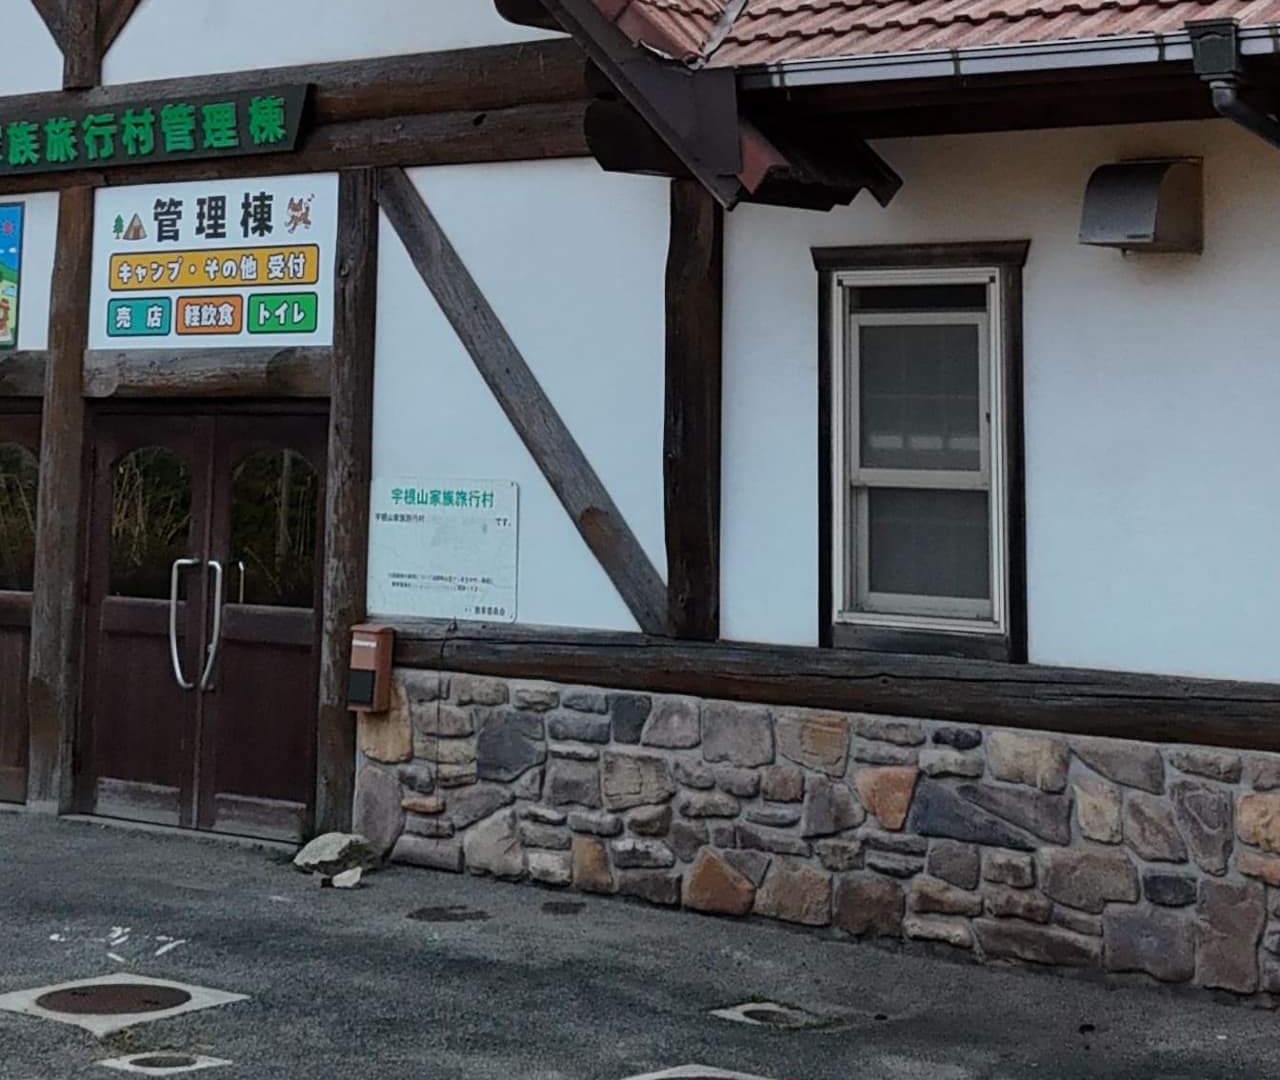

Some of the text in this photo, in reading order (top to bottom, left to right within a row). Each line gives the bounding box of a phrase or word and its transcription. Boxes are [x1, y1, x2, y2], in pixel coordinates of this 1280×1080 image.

[153, 192, 274, 242] 管理棟
[268, 254, 306, 278] 受付
[184, 303, 234, 327] 軽飲食
[258, 302, 305, 326] トイレ
[391, 488, 494, 508] 宇根山家族旅行村
